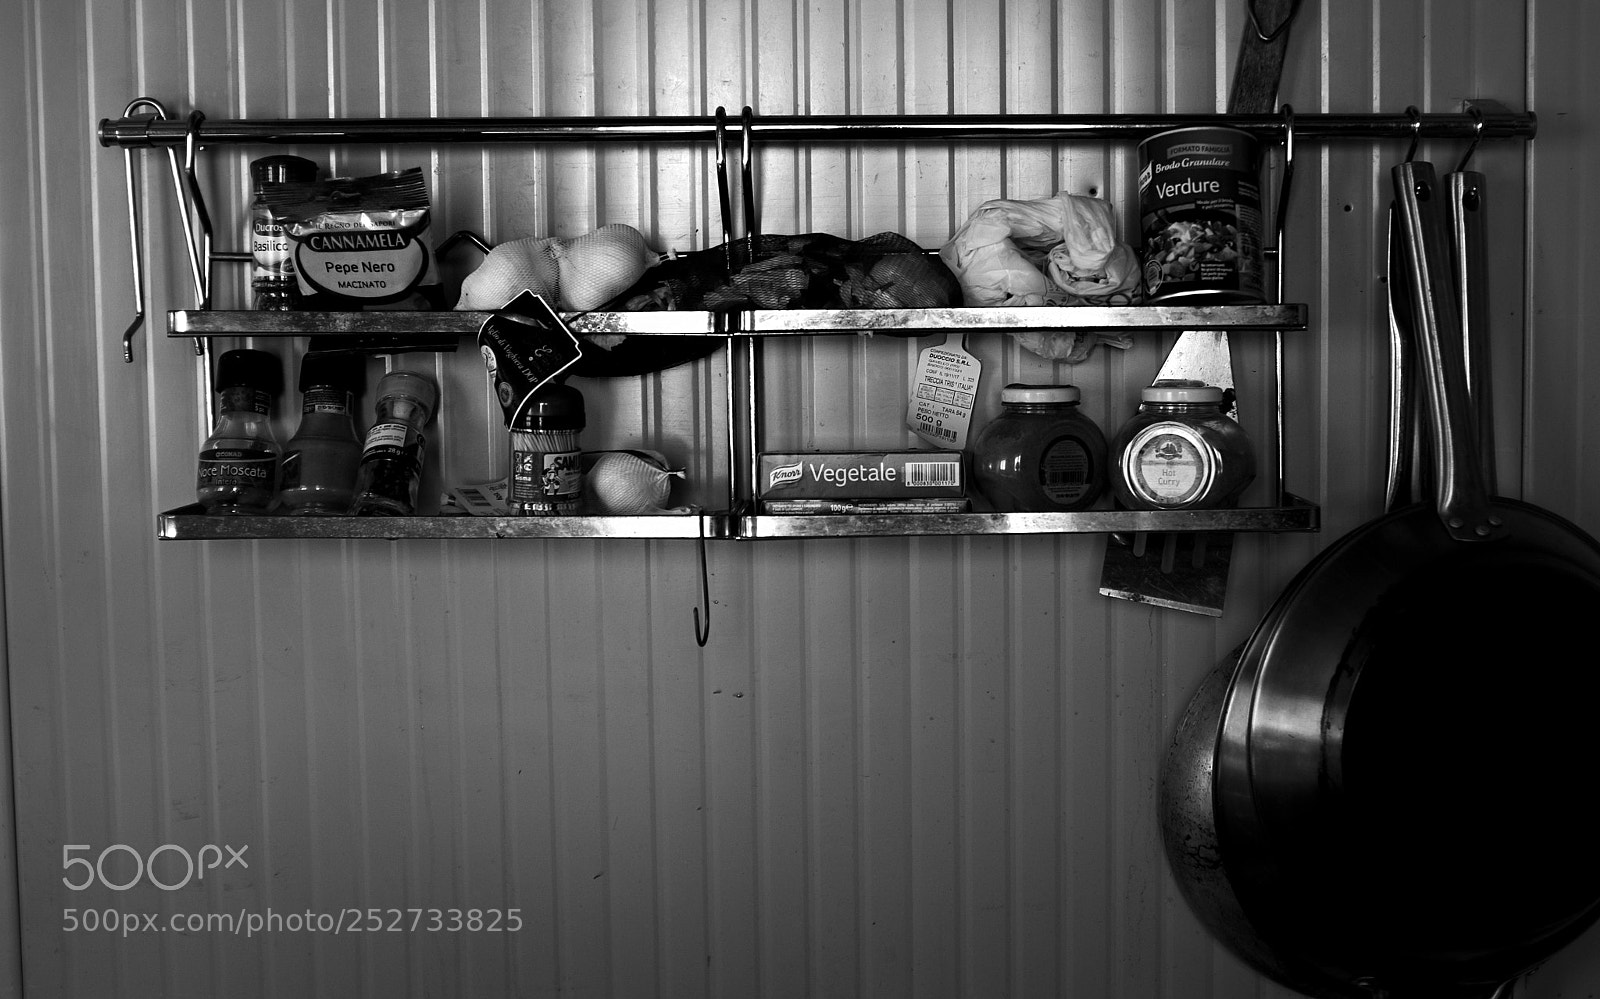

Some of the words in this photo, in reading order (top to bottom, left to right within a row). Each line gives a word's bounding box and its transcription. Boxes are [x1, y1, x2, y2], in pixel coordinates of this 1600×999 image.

[1170, 145, 1201, 155] FORMATO
[1201, 145, 1231, 153] FAMIGLIA
[1155, 160, 1181, 174] Brodo
[1181, 157, 1231, 168] Granulare
[1155, 177, 1221, 200] Verdure
[255, 223, 283, 233] Ducros
[324, 222, 351, 230] REGNO
[310, 232, 406, 251] CANNAMELA
[325, 262, 359, 275] Pepe
[362, 262, 395, 273] Nero
[337, 280, 387, 289] MACINATO
[521, 367, 539, 385] DOP
[917, 407, 931, 415] PESO
[932, 410, 949, 419] NETTO
[942, 406, 955, 415] TARA
[915, 413, 934, 423] 500
[219, 464, 267, 479] Moscata
[771, 468, 802, 481] Knorr
[809, 462, 897, 487] Vegetale
[1162, 469, 1176, 477] Hot
[1158, 477, 1181, 487] Curry
